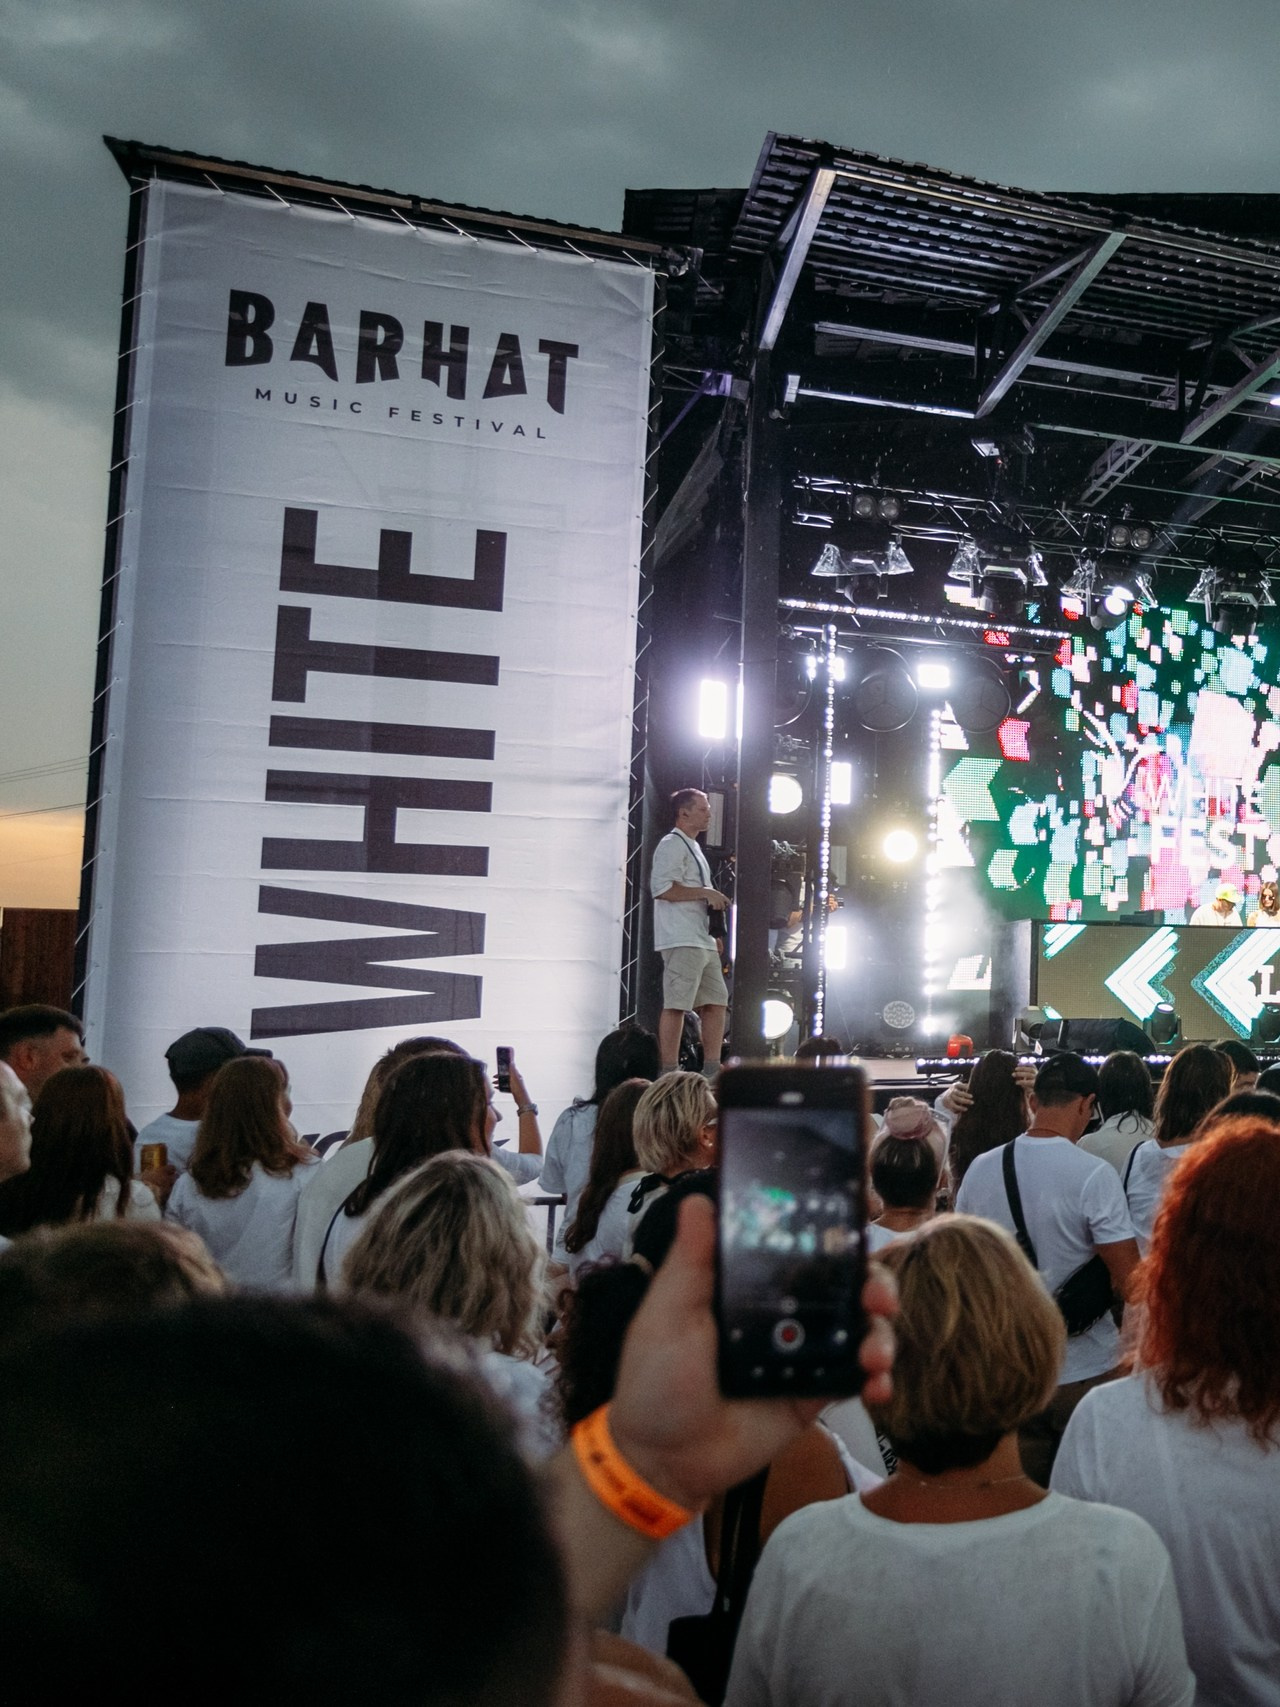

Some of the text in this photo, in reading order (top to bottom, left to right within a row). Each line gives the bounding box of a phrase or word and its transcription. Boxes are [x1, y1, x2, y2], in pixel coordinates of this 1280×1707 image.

[225, 288, 580, 415] BARHAT
[255, 387, 547, 440] MUSIC FESTIVAL
[250, 506, 508, 1041] WHITE
[1151, 817, 1266, 870] FEST
